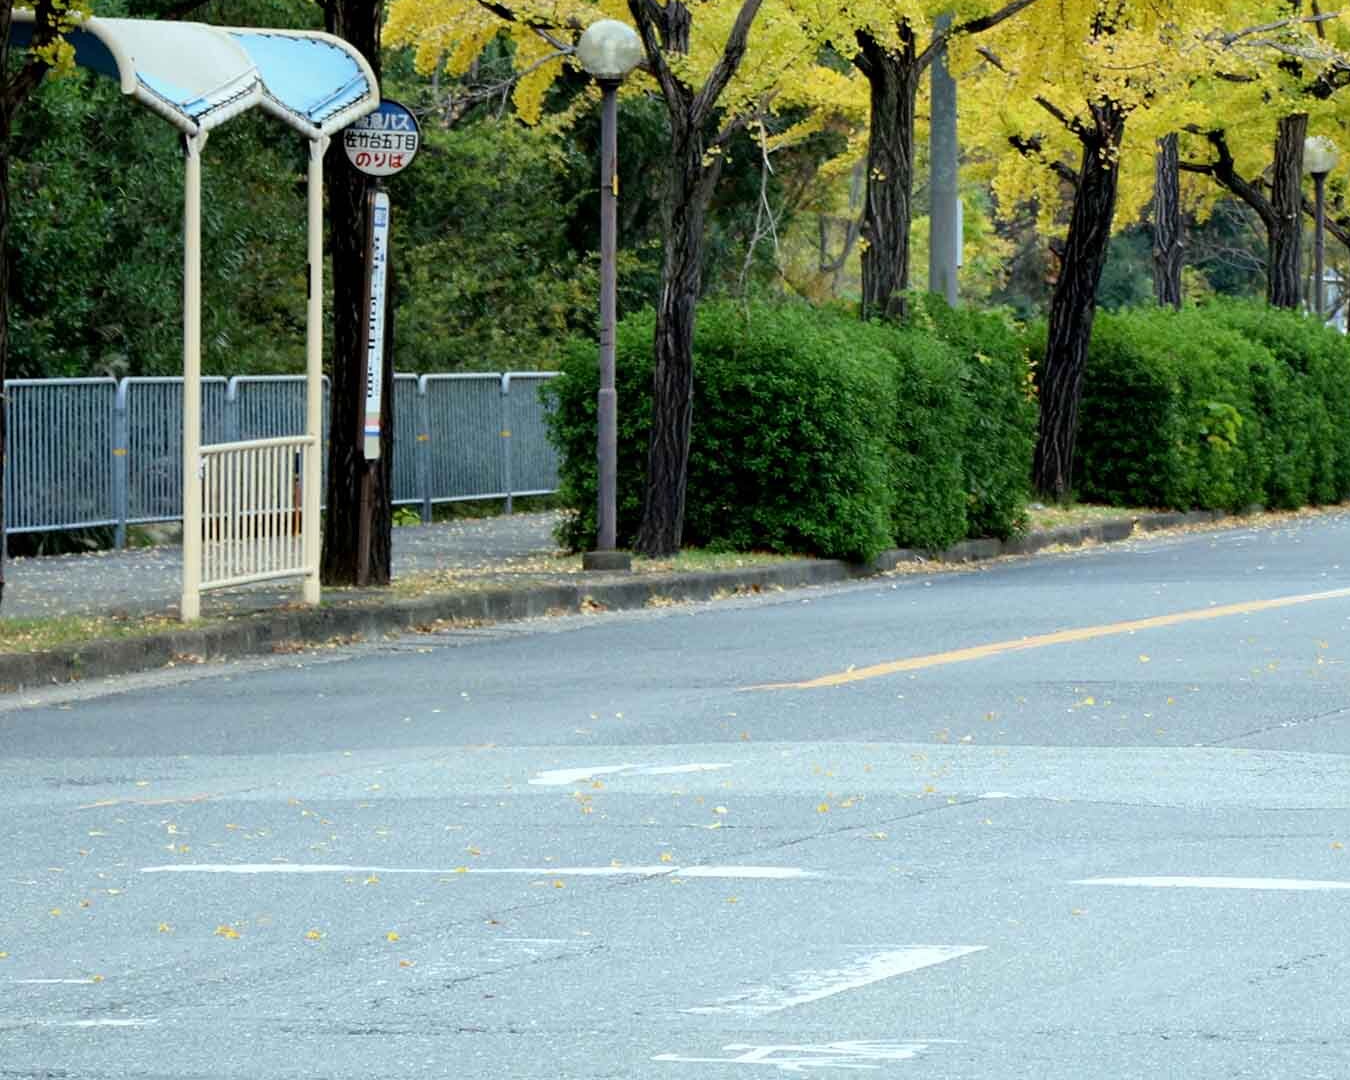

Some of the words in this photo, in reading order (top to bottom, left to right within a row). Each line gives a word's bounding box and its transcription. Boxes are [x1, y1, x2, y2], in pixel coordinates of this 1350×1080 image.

[345, 131, 416, 151] 佐竹台五丁目
[355, 151, 404, 168] のりば
